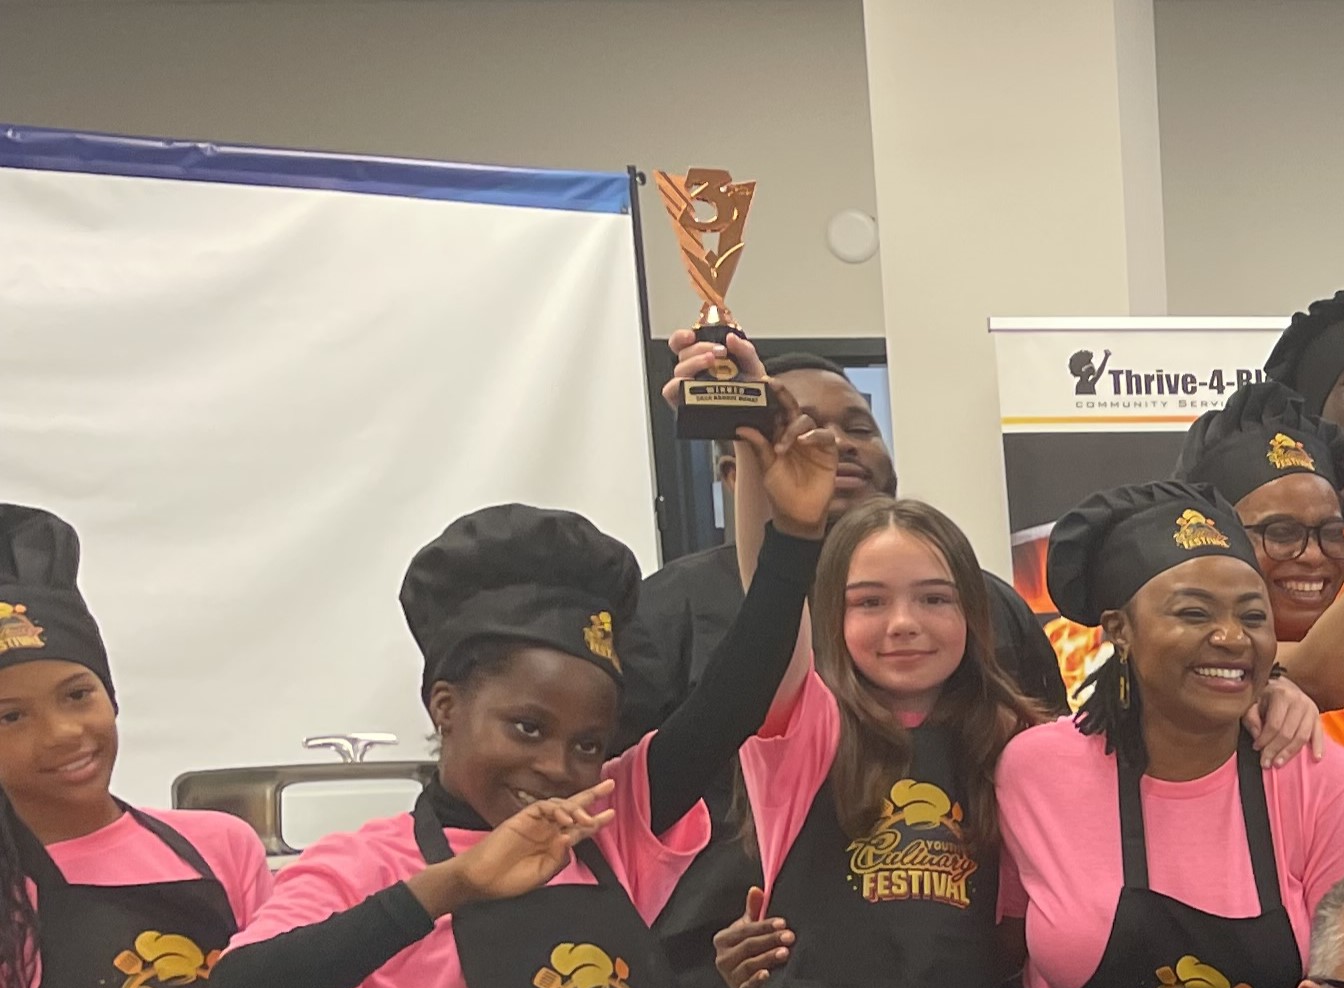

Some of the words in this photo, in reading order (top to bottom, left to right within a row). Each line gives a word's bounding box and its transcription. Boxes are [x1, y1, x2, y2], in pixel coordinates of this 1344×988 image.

[1108, 369, 1267, 396] Thrive-4-Bl
[1075, 400, 1168, 408] COMMUNITY
[1178, 399, 1225, 408] SERVI
[845, 829, 978, 883] Culinary
[863, 870, 971, 907] FESTIVAL
